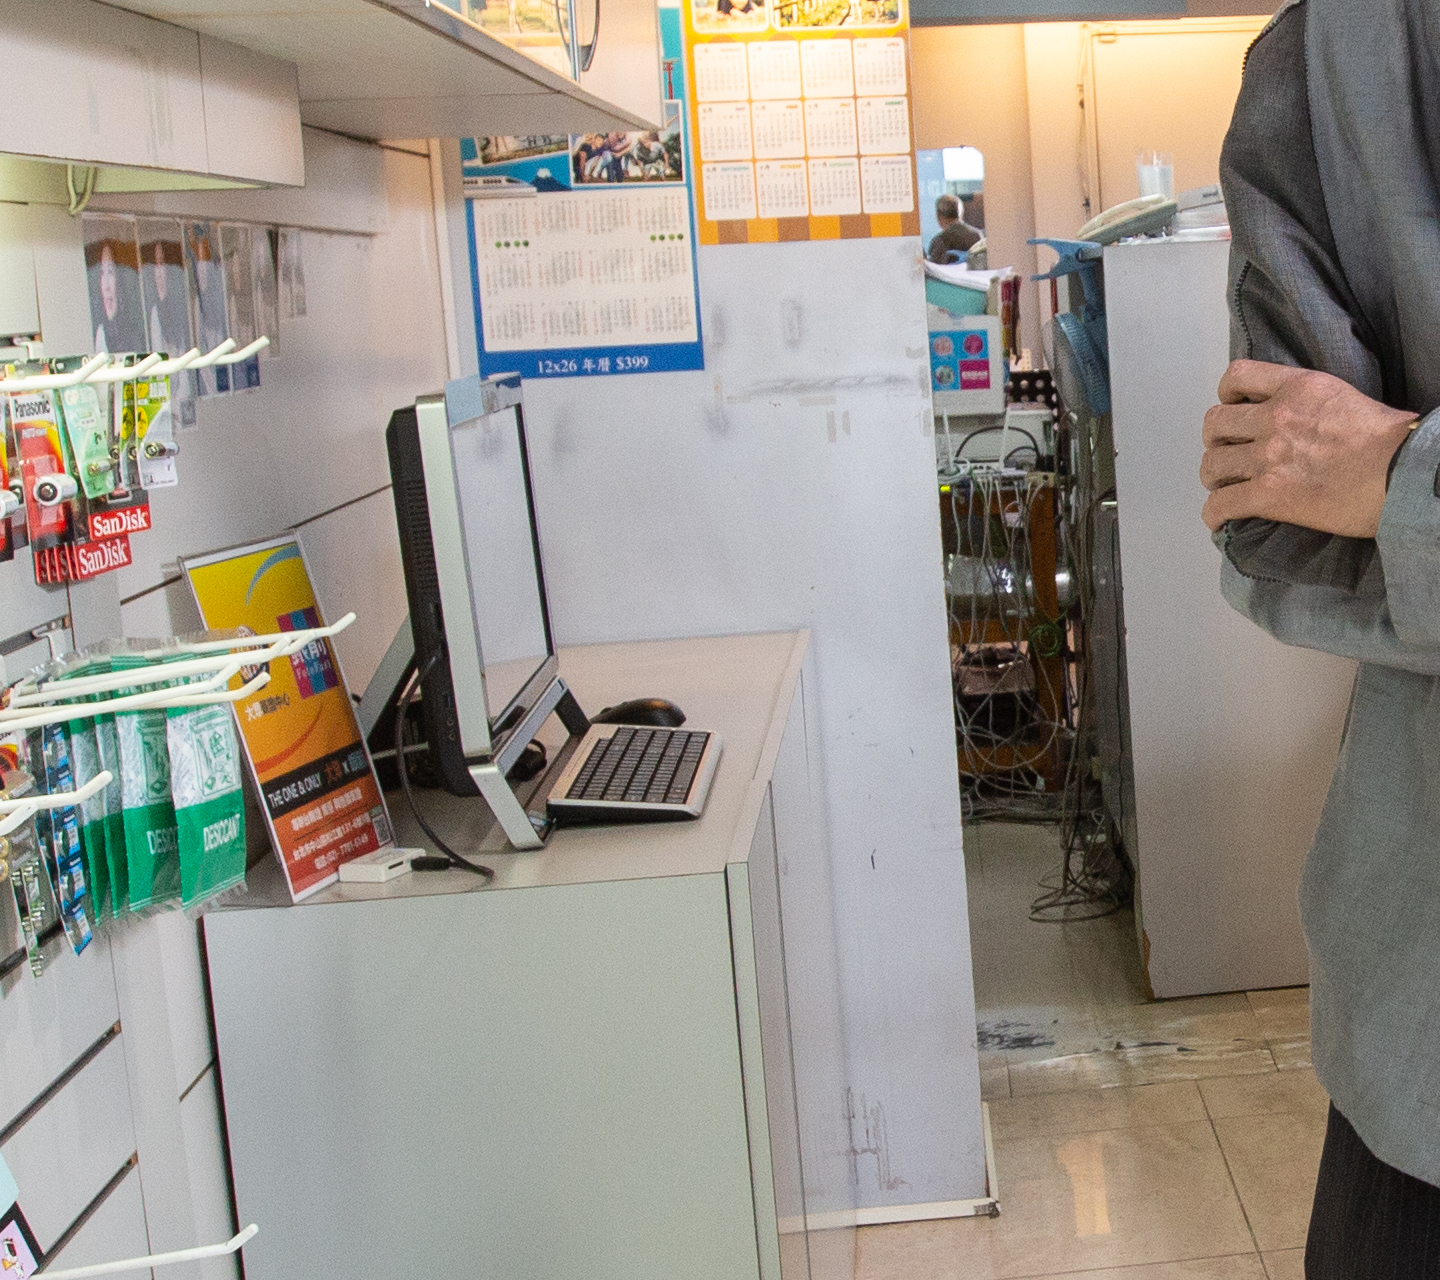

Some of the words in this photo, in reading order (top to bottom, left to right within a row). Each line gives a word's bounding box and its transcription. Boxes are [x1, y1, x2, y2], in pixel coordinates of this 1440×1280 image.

[537, 358, 578, 375] 12x26
[615, 355, 650, 371] $399
[13, 398, 51, 419] Panasonic
[93, 511, 149, 537] SanDisk
[78, 539, 129, 575] SanDisk
[268, 790, 284, 808] THE
[282, 783, 299, 802] ONE
[304, 773, 322, 791] ONLY
